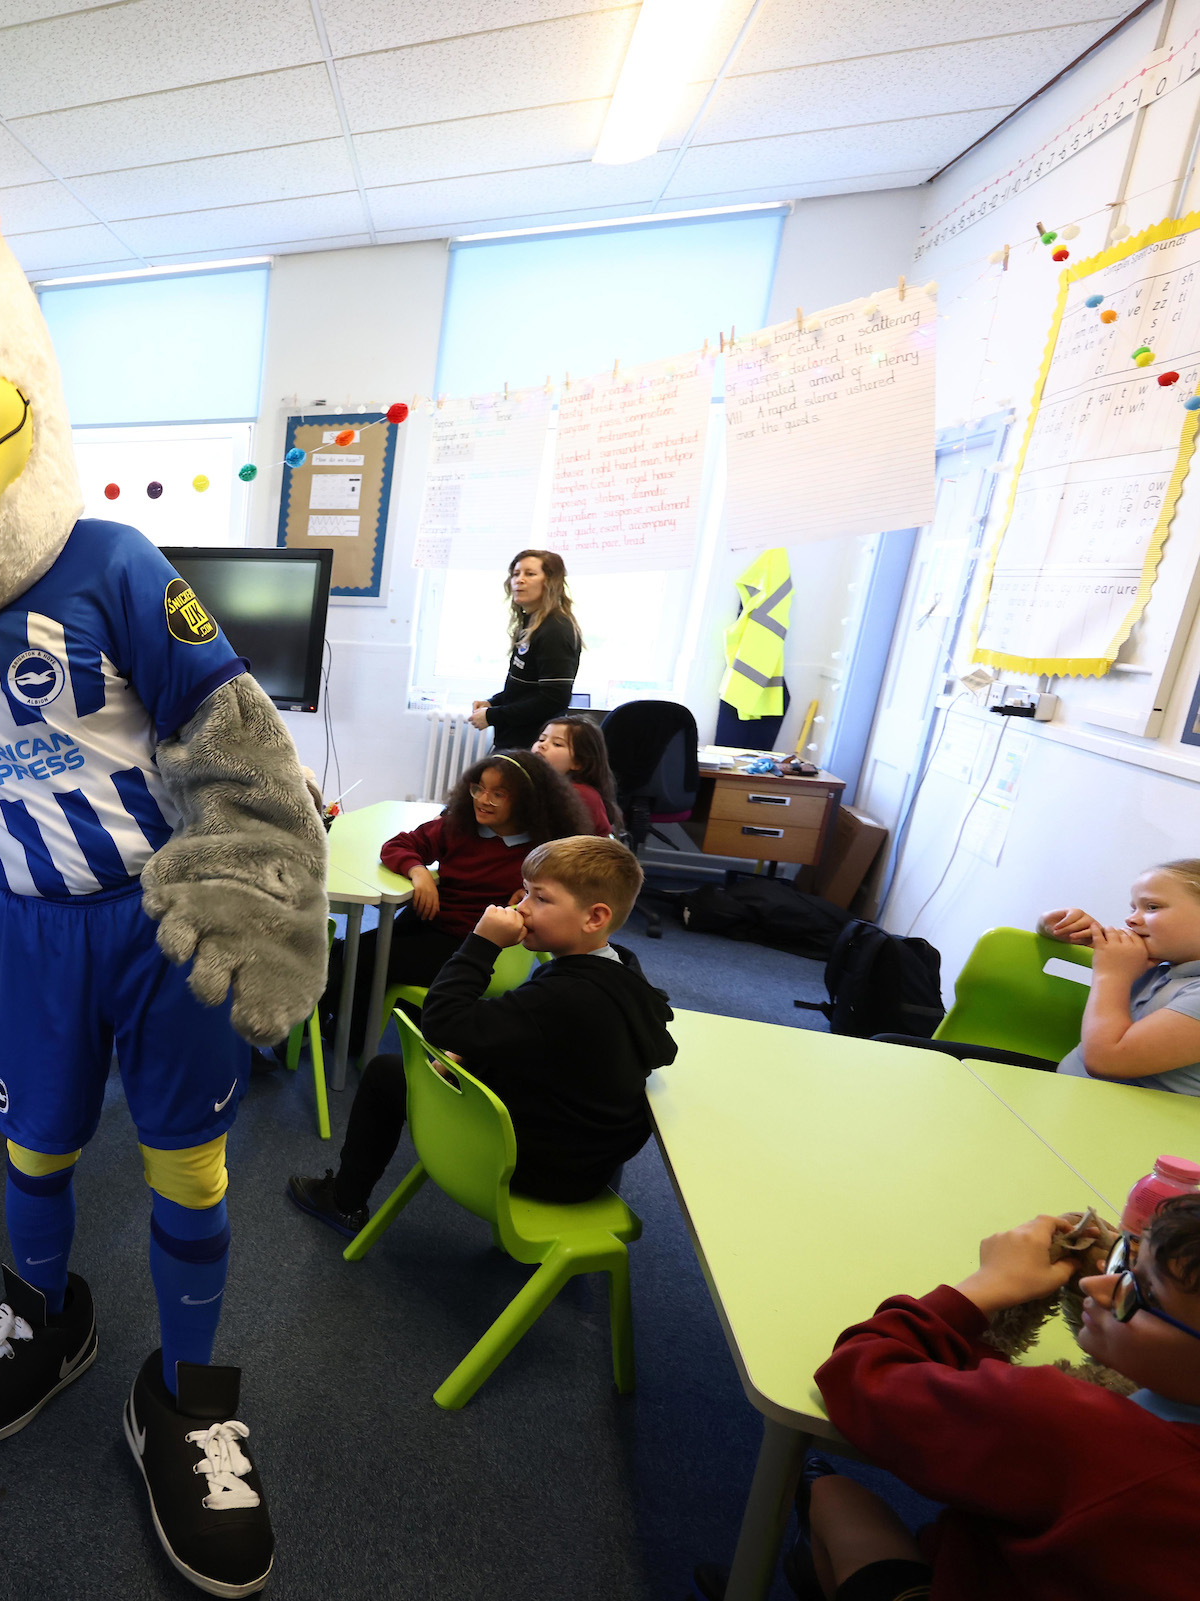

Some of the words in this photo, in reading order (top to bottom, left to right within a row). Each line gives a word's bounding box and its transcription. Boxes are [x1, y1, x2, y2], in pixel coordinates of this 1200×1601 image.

[1113, 101, 1124, 120] -2
[1132, 88, 1143, 106] -1
[1156, 76, 1167, 96] 0
[1147, 236, 1187, 255] Sounds
[824, 312, 855, 329] room
[856, 310, 921, 337] scattering
[789, 348, 841, 375] declared
[738, 379, 798, 406] anticipated
[877, 350, 920, 369] Henry
[767, 396, 798, 419] rapid
[845, 369, 896, 396] ushered
[651, 429, 699, 449] ambushed
[615, 456, 638, 470] hand
[652, 468, 678, 481] house
[1148, 481, 1167, 492] ow
[1094, 584, 1114, 595] ear
[1116, 584, 1138, 596] ure
[11, 651, 36, 669] BRIGHTON
[42, 653, 57, 666] HOVE
[26, 697, 49, 706] ALBION
